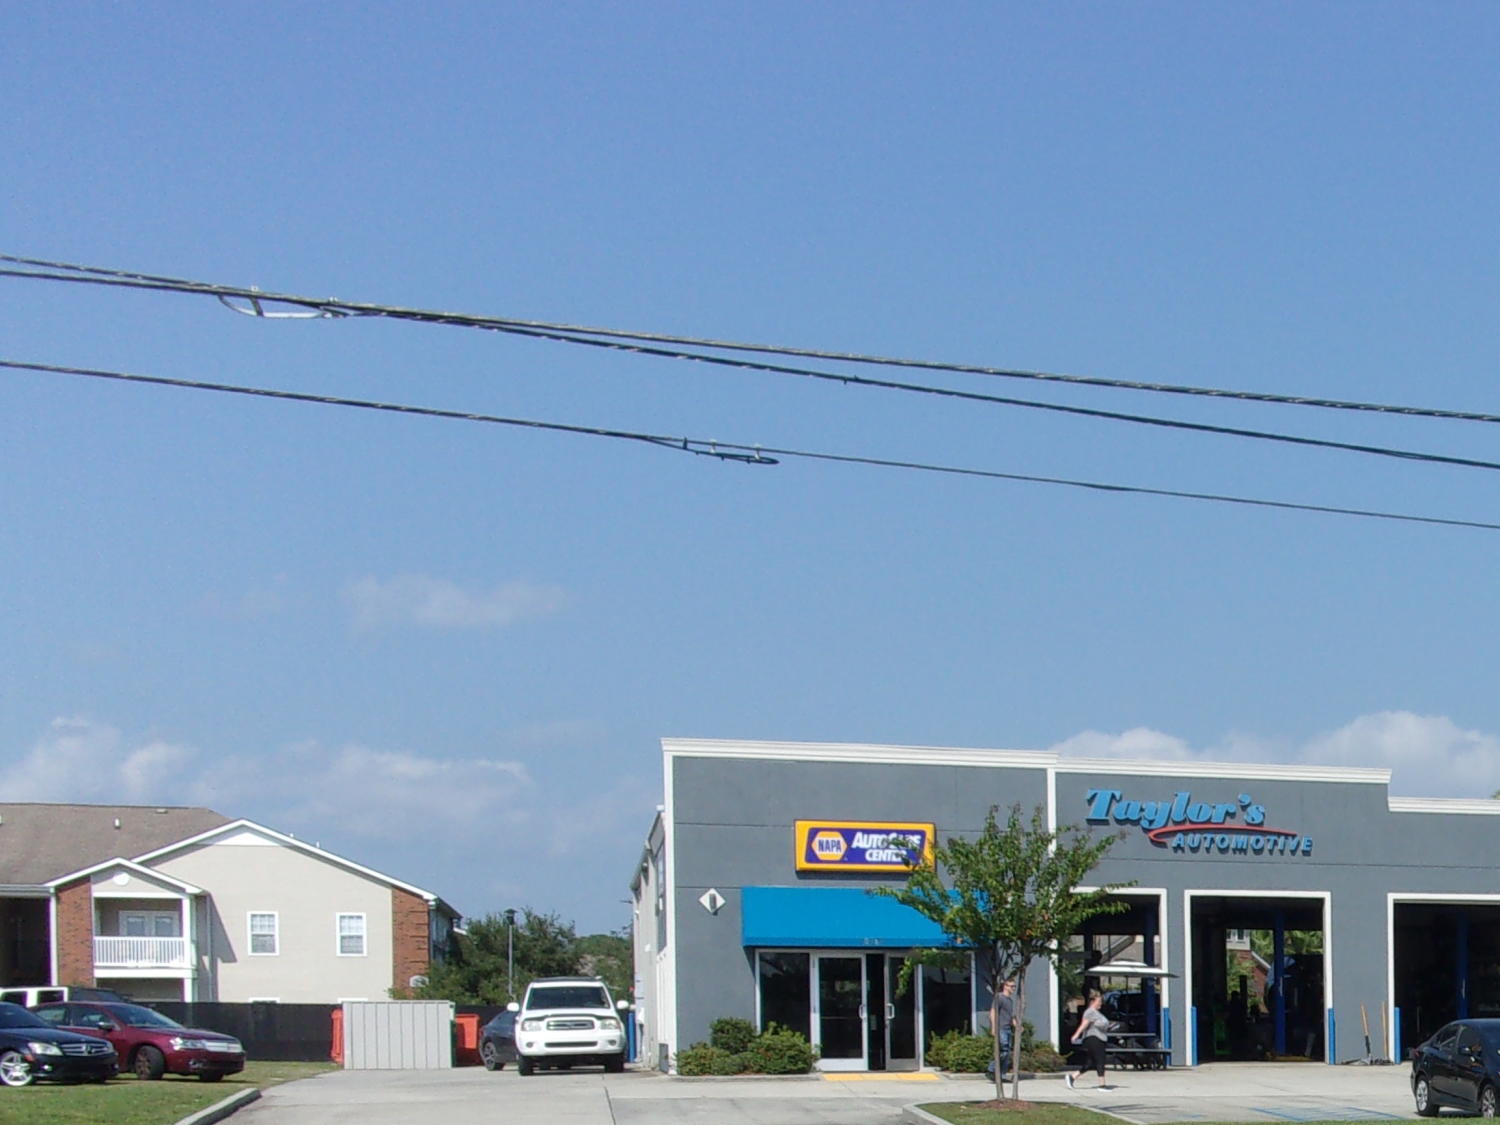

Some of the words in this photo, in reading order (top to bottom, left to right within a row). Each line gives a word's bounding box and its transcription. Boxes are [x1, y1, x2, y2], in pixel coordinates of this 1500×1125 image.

[1086, 789, 1265, 829] Taylor's
[818, 839, 842, 852] NAPA
[1172, 832, 1313, 854] AUTOMOTIVE
